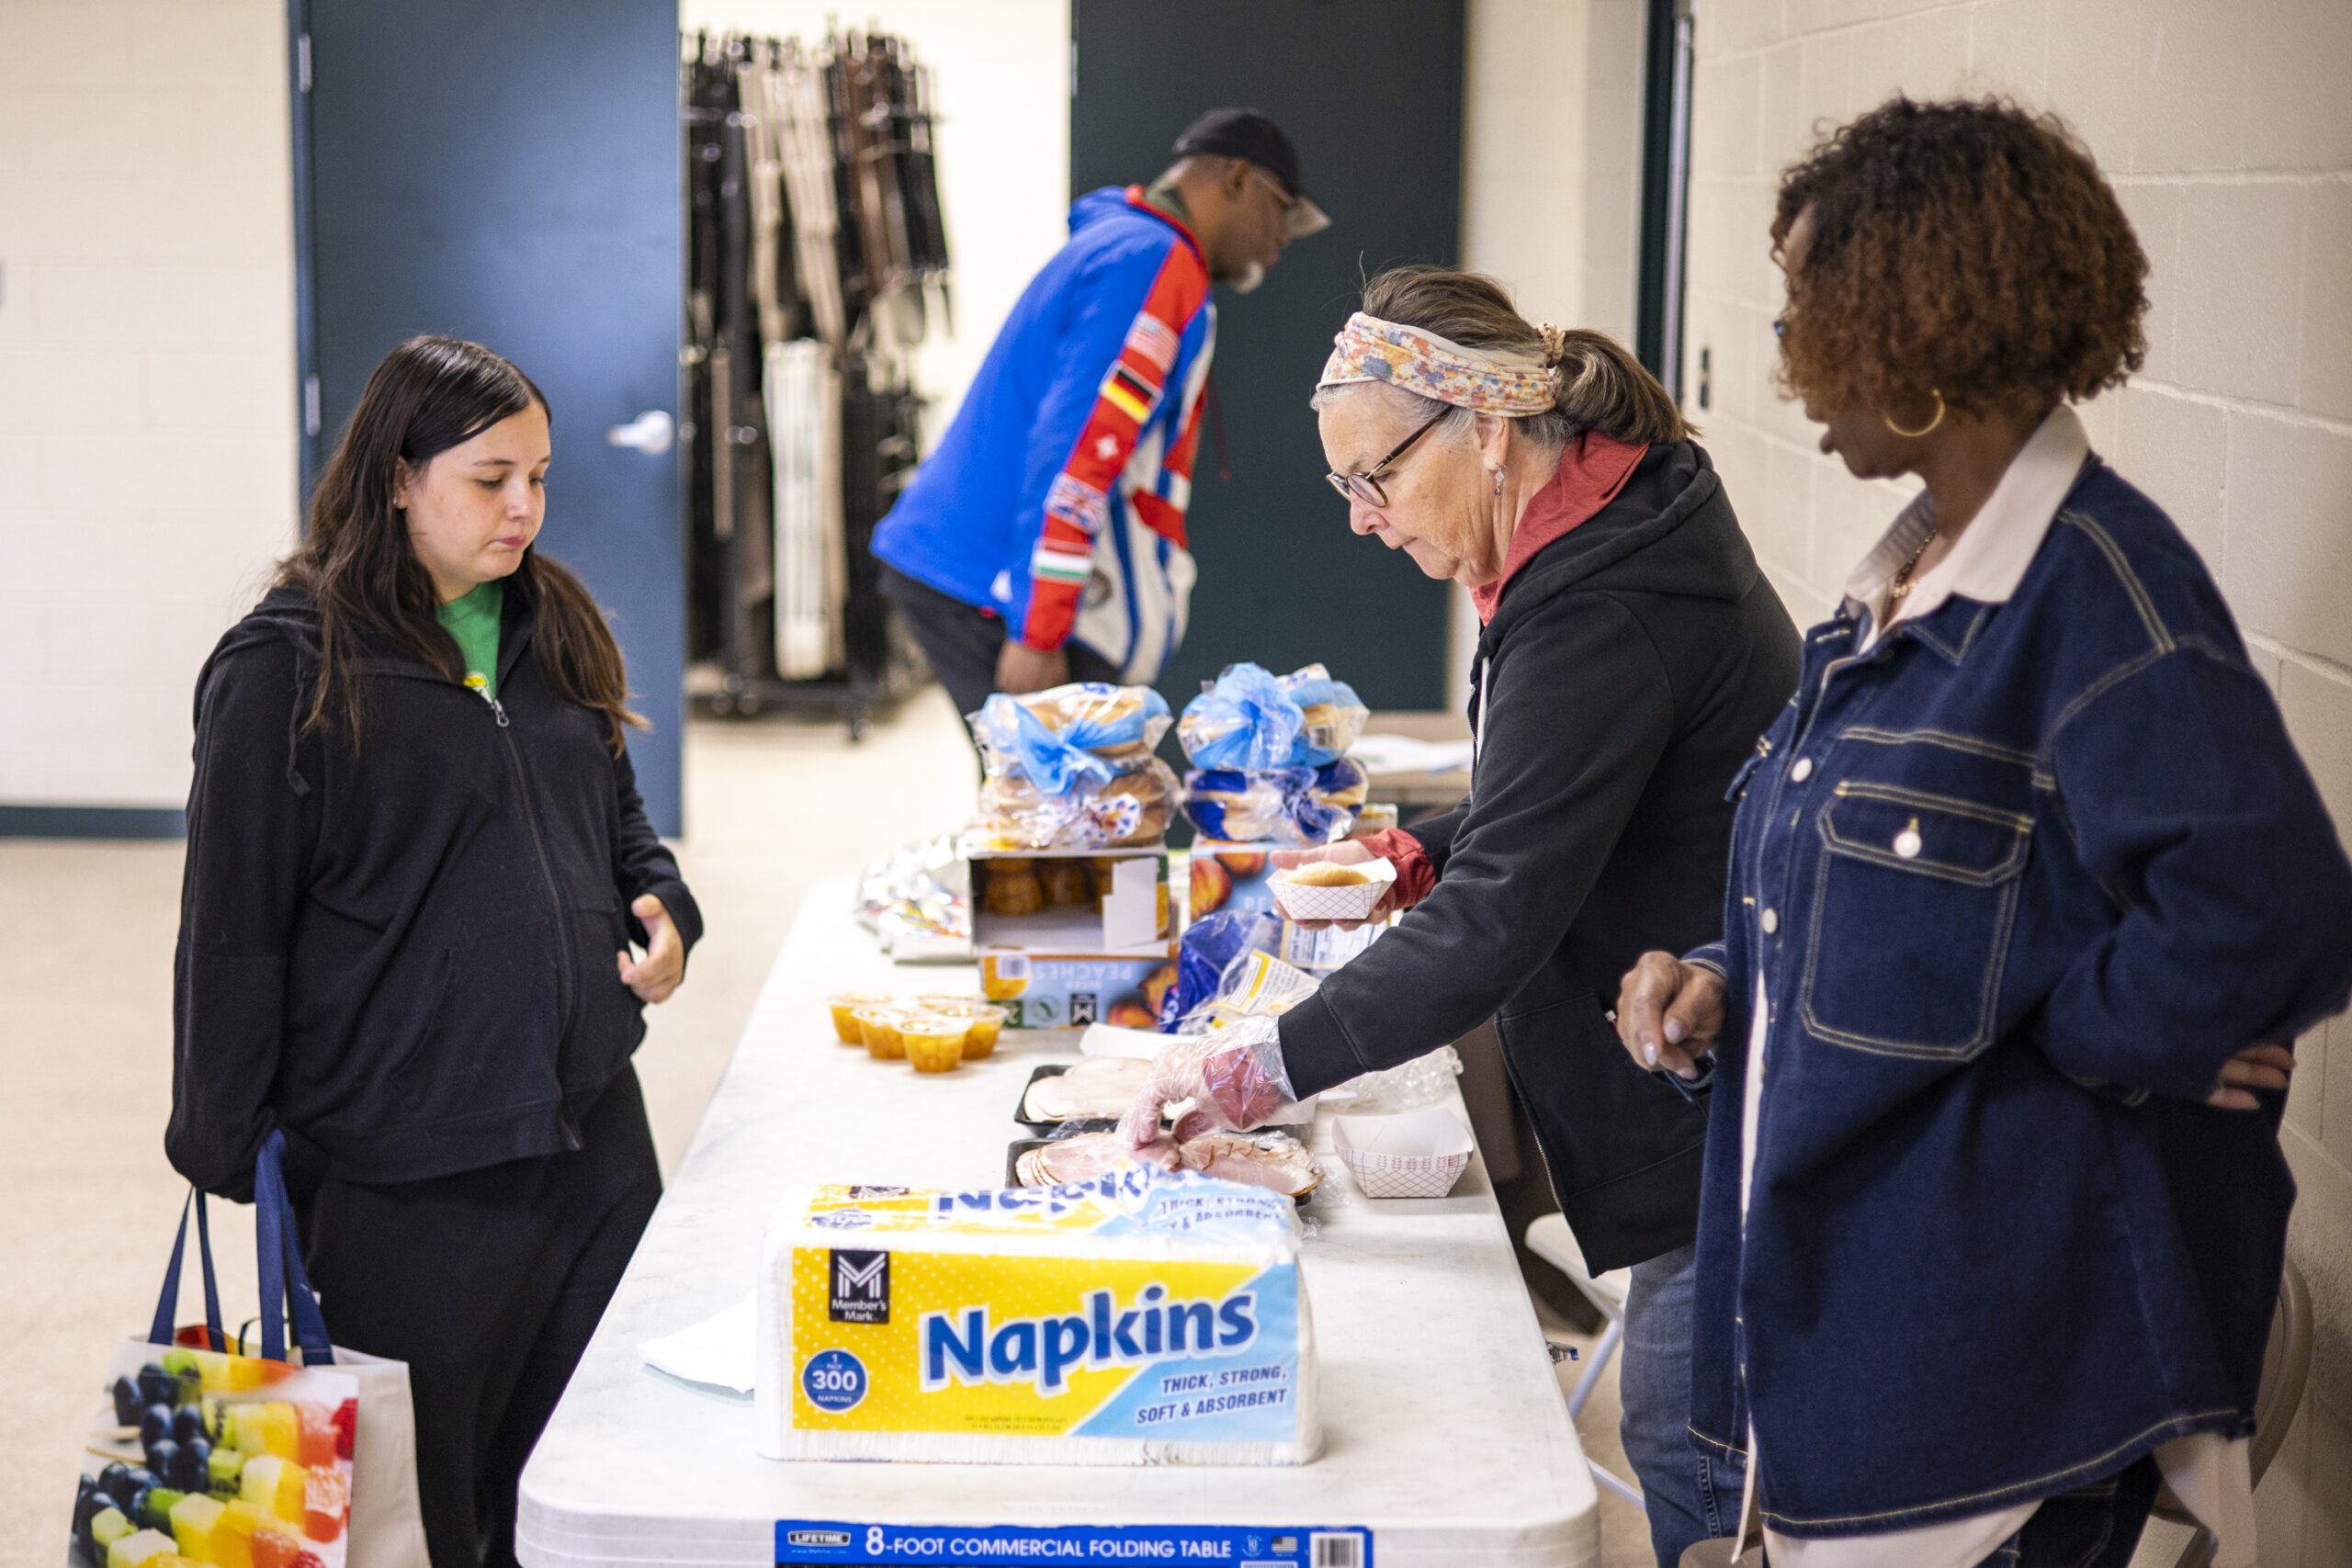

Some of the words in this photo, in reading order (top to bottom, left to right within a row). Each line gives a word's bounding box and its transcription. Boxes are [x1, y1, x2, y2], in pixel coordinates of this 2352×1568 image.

[1035, 964, 1132, 980] PEACHES
[831, 1299, 887, 1312] Member's
[844, 1311, 874, 1322] Mark
[928, 1286, 1255, 1387] Napkins
[831, 1353, 838, 1363] 1
[811, 1370, 857, 1392] 300
[1163, 1374, 1214, 1394] THICK,
[1219, 1366, 1287, 1386] STRONG,
[818, 1394, 852, 1404] NAPKINS
[1137, 1404, 1177, 1424] SOFT
[1181, 1402, 1191, 1417] &
[1196, 1389, 1288, 1415] ABSORBENT
[796, 1533, 844, 1544] LIFETIME
[865, 1526, 944, 1556] 8-FOOT
[950, 1538, 1084, 1557] COMMERCIAL
[1090, 1540, 1175, 1558] FOLDING
[1180, 1540, 1232, 1558] TABLE
